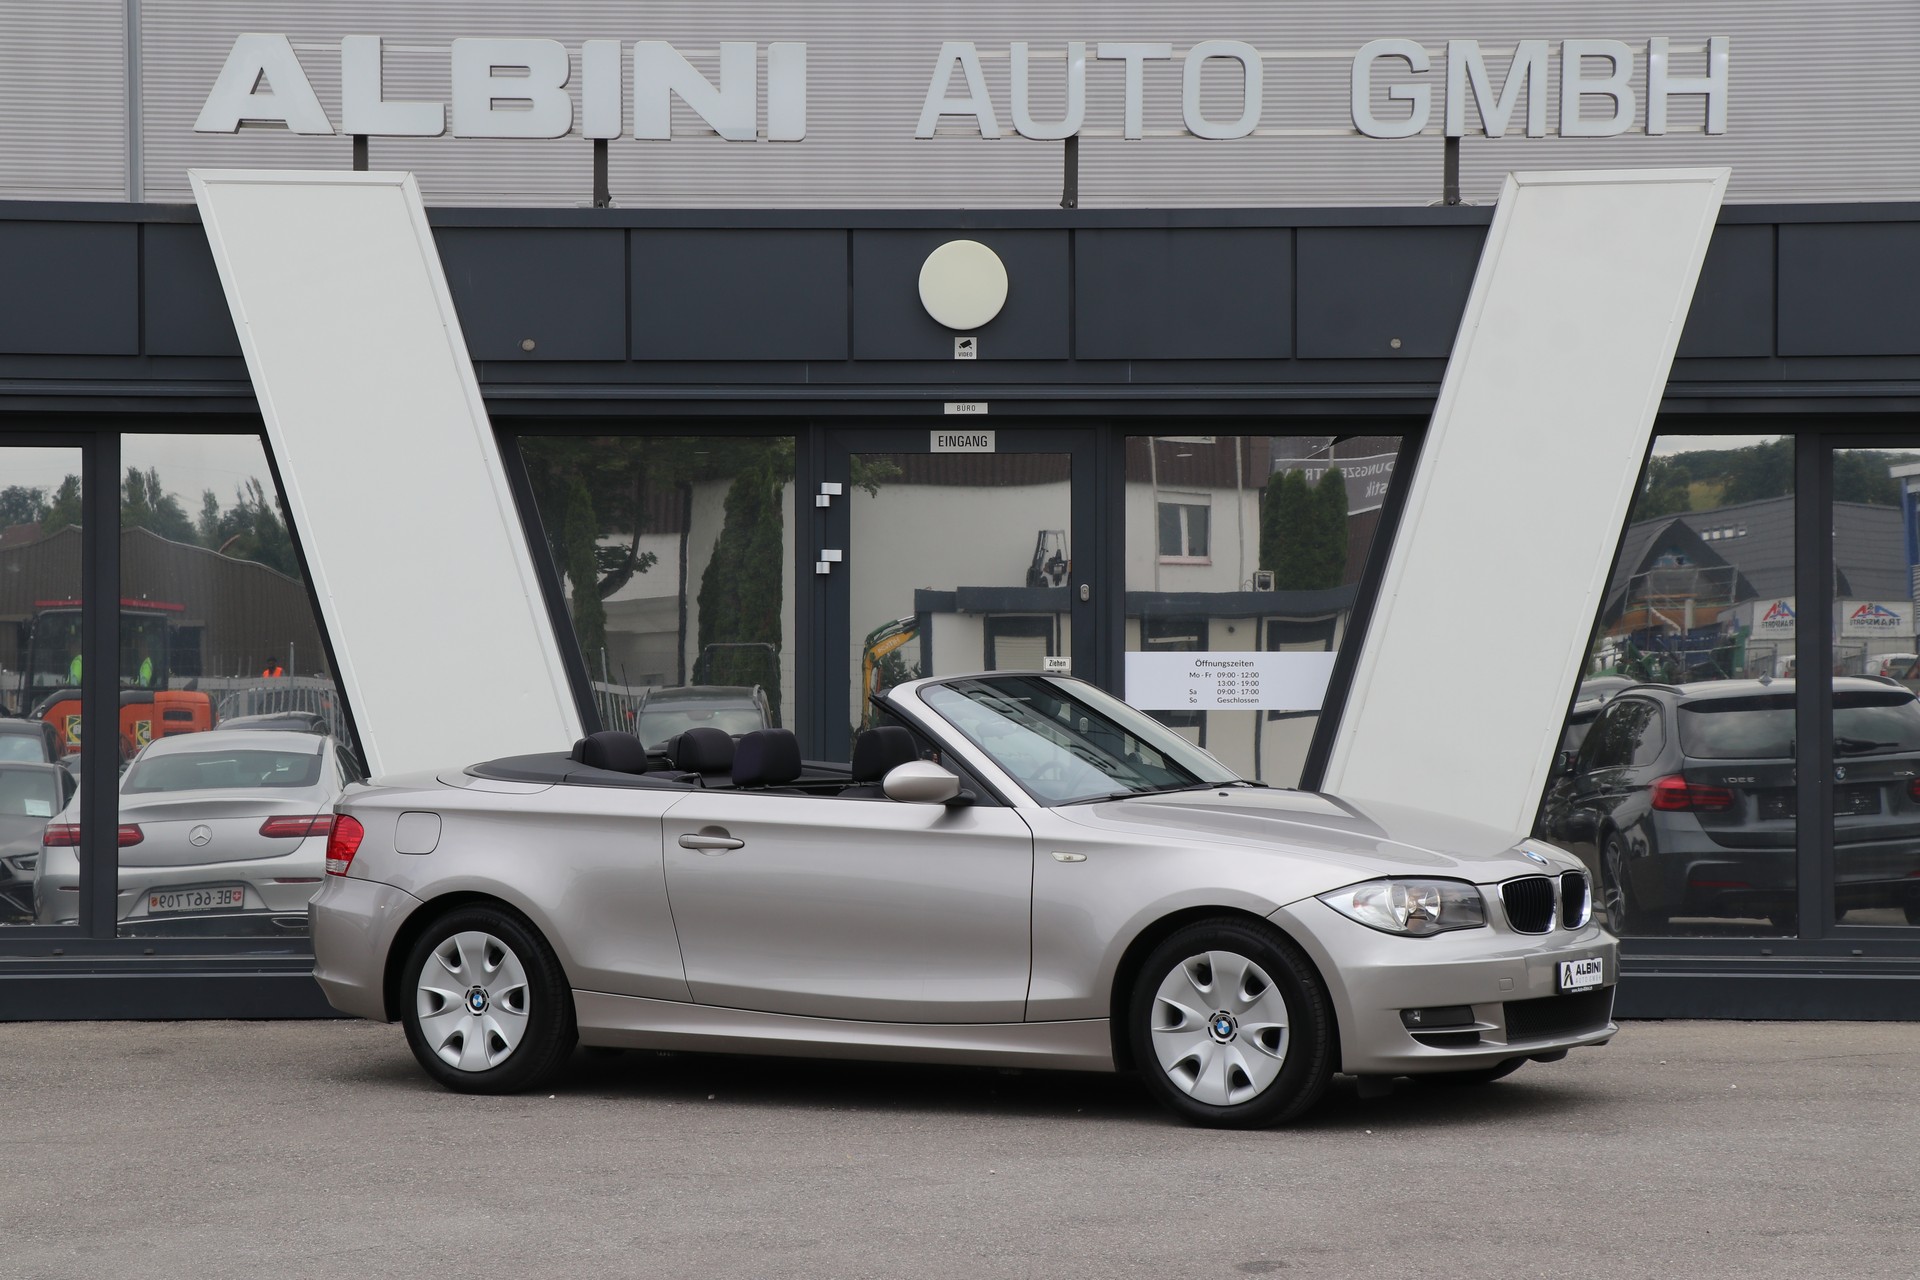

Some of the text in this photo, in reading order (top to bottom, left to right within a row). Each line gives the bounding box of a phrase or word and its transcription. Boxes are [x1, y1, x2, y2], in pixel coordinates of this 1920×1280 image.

[193, 32, 1730, 141] ALBINI AUTO GMBH
[938, 435, 988, 447] EINGANG
[1049, 659, 1067, 667] Ziehen
[1195, 658, 1254, 668] Öffnungszeiten
[1217, 696, 1260, 704] Geschlossen
[1576, 961, 1601, 975] ALBINI
